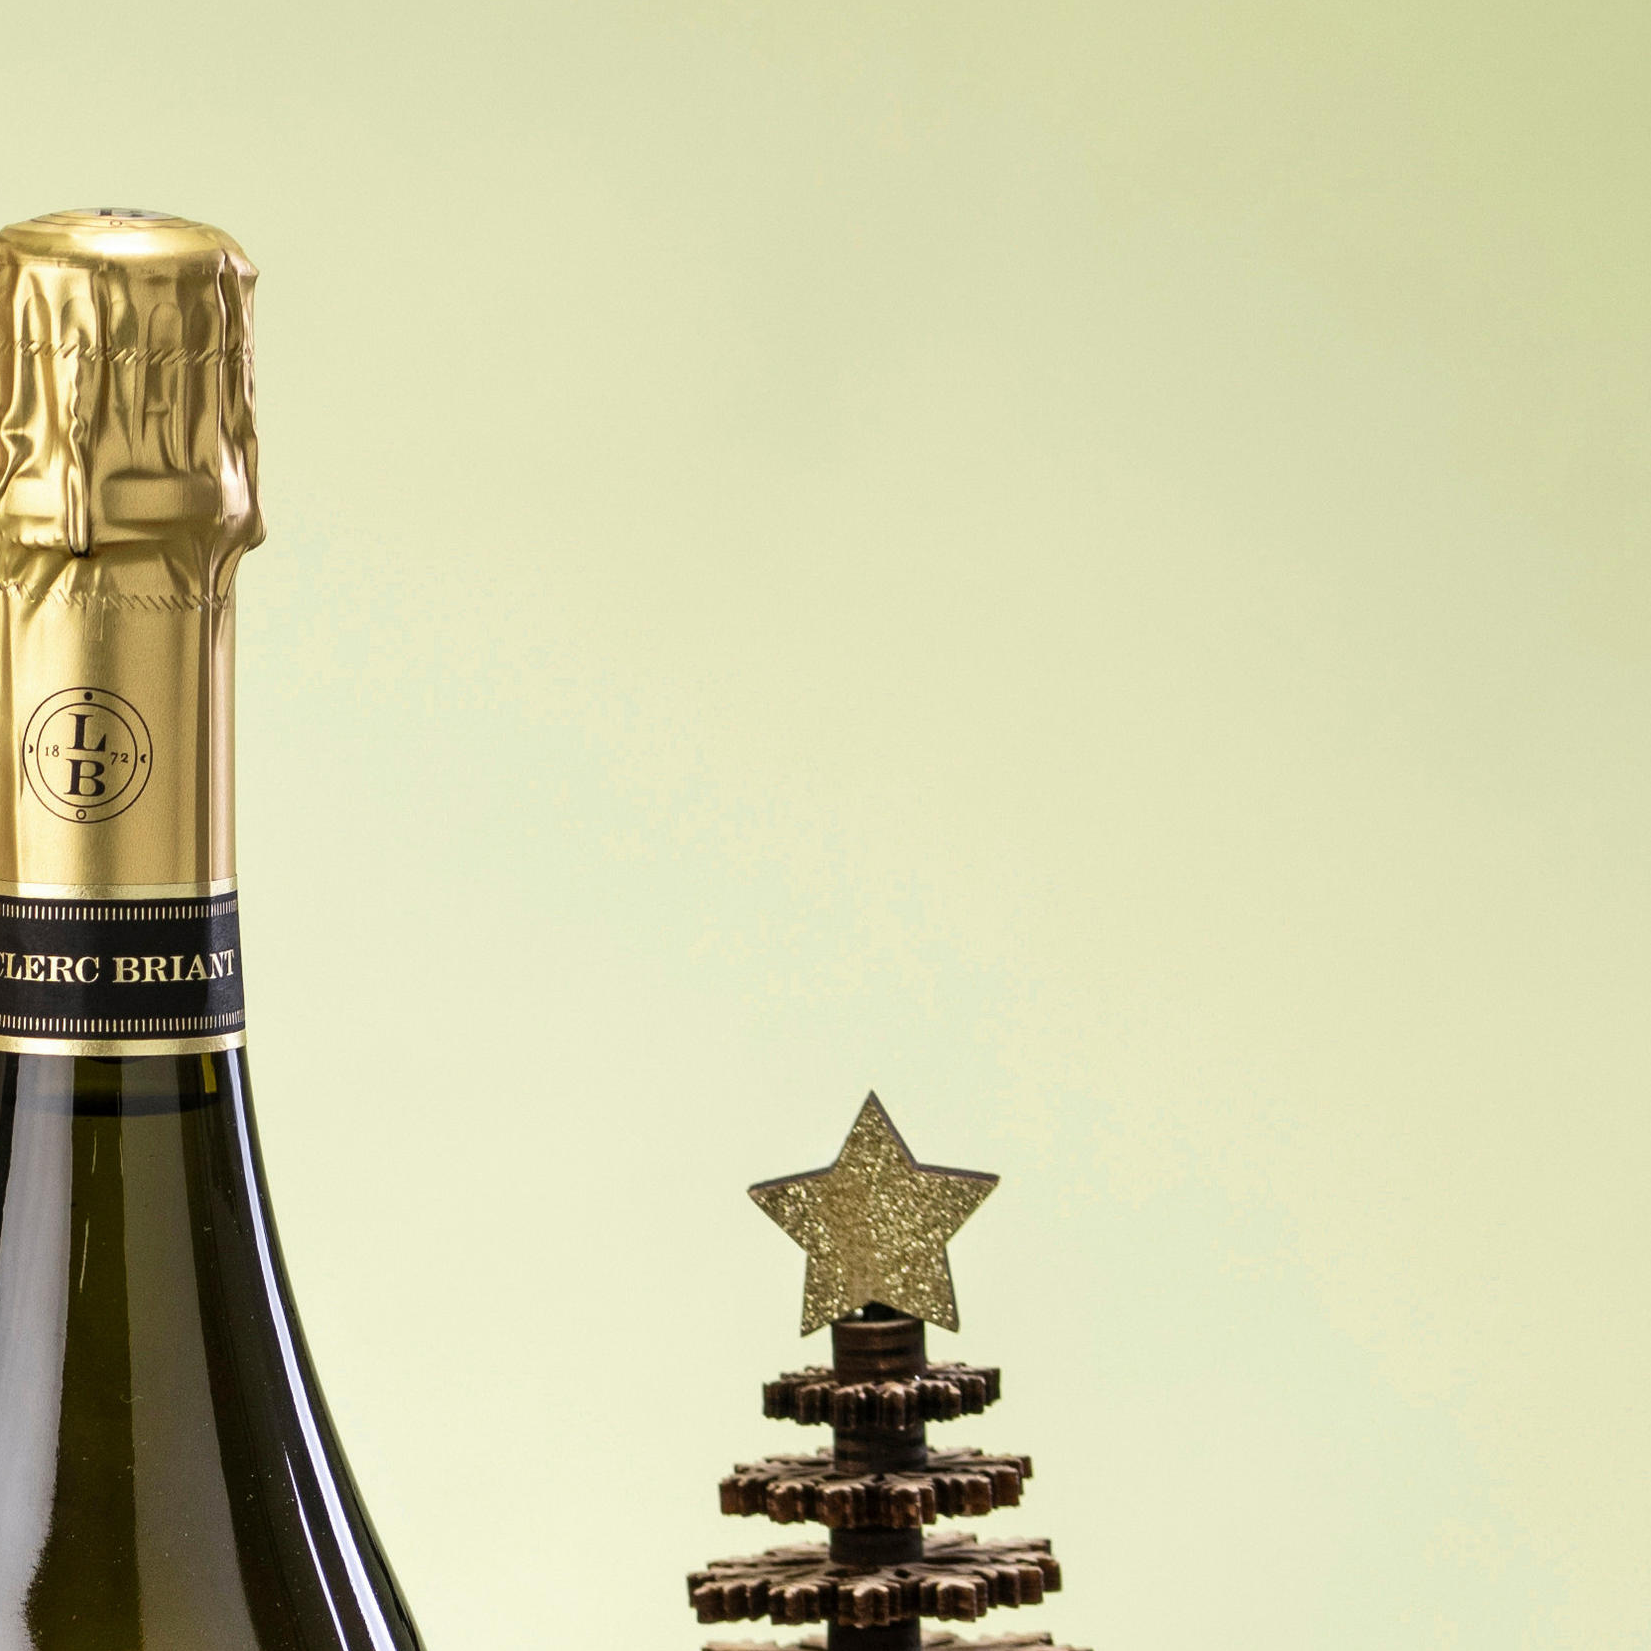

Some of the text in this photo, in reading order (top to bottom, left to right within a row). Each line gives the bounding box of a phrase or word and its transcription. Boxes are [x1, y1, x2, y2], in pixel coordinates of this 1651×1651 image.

[68, 713, 107, 752] L
[45, 744, 129, 766] 18 72
[64, 759, 106, 796] B
[113, 950, 235, 984] BRIANT
